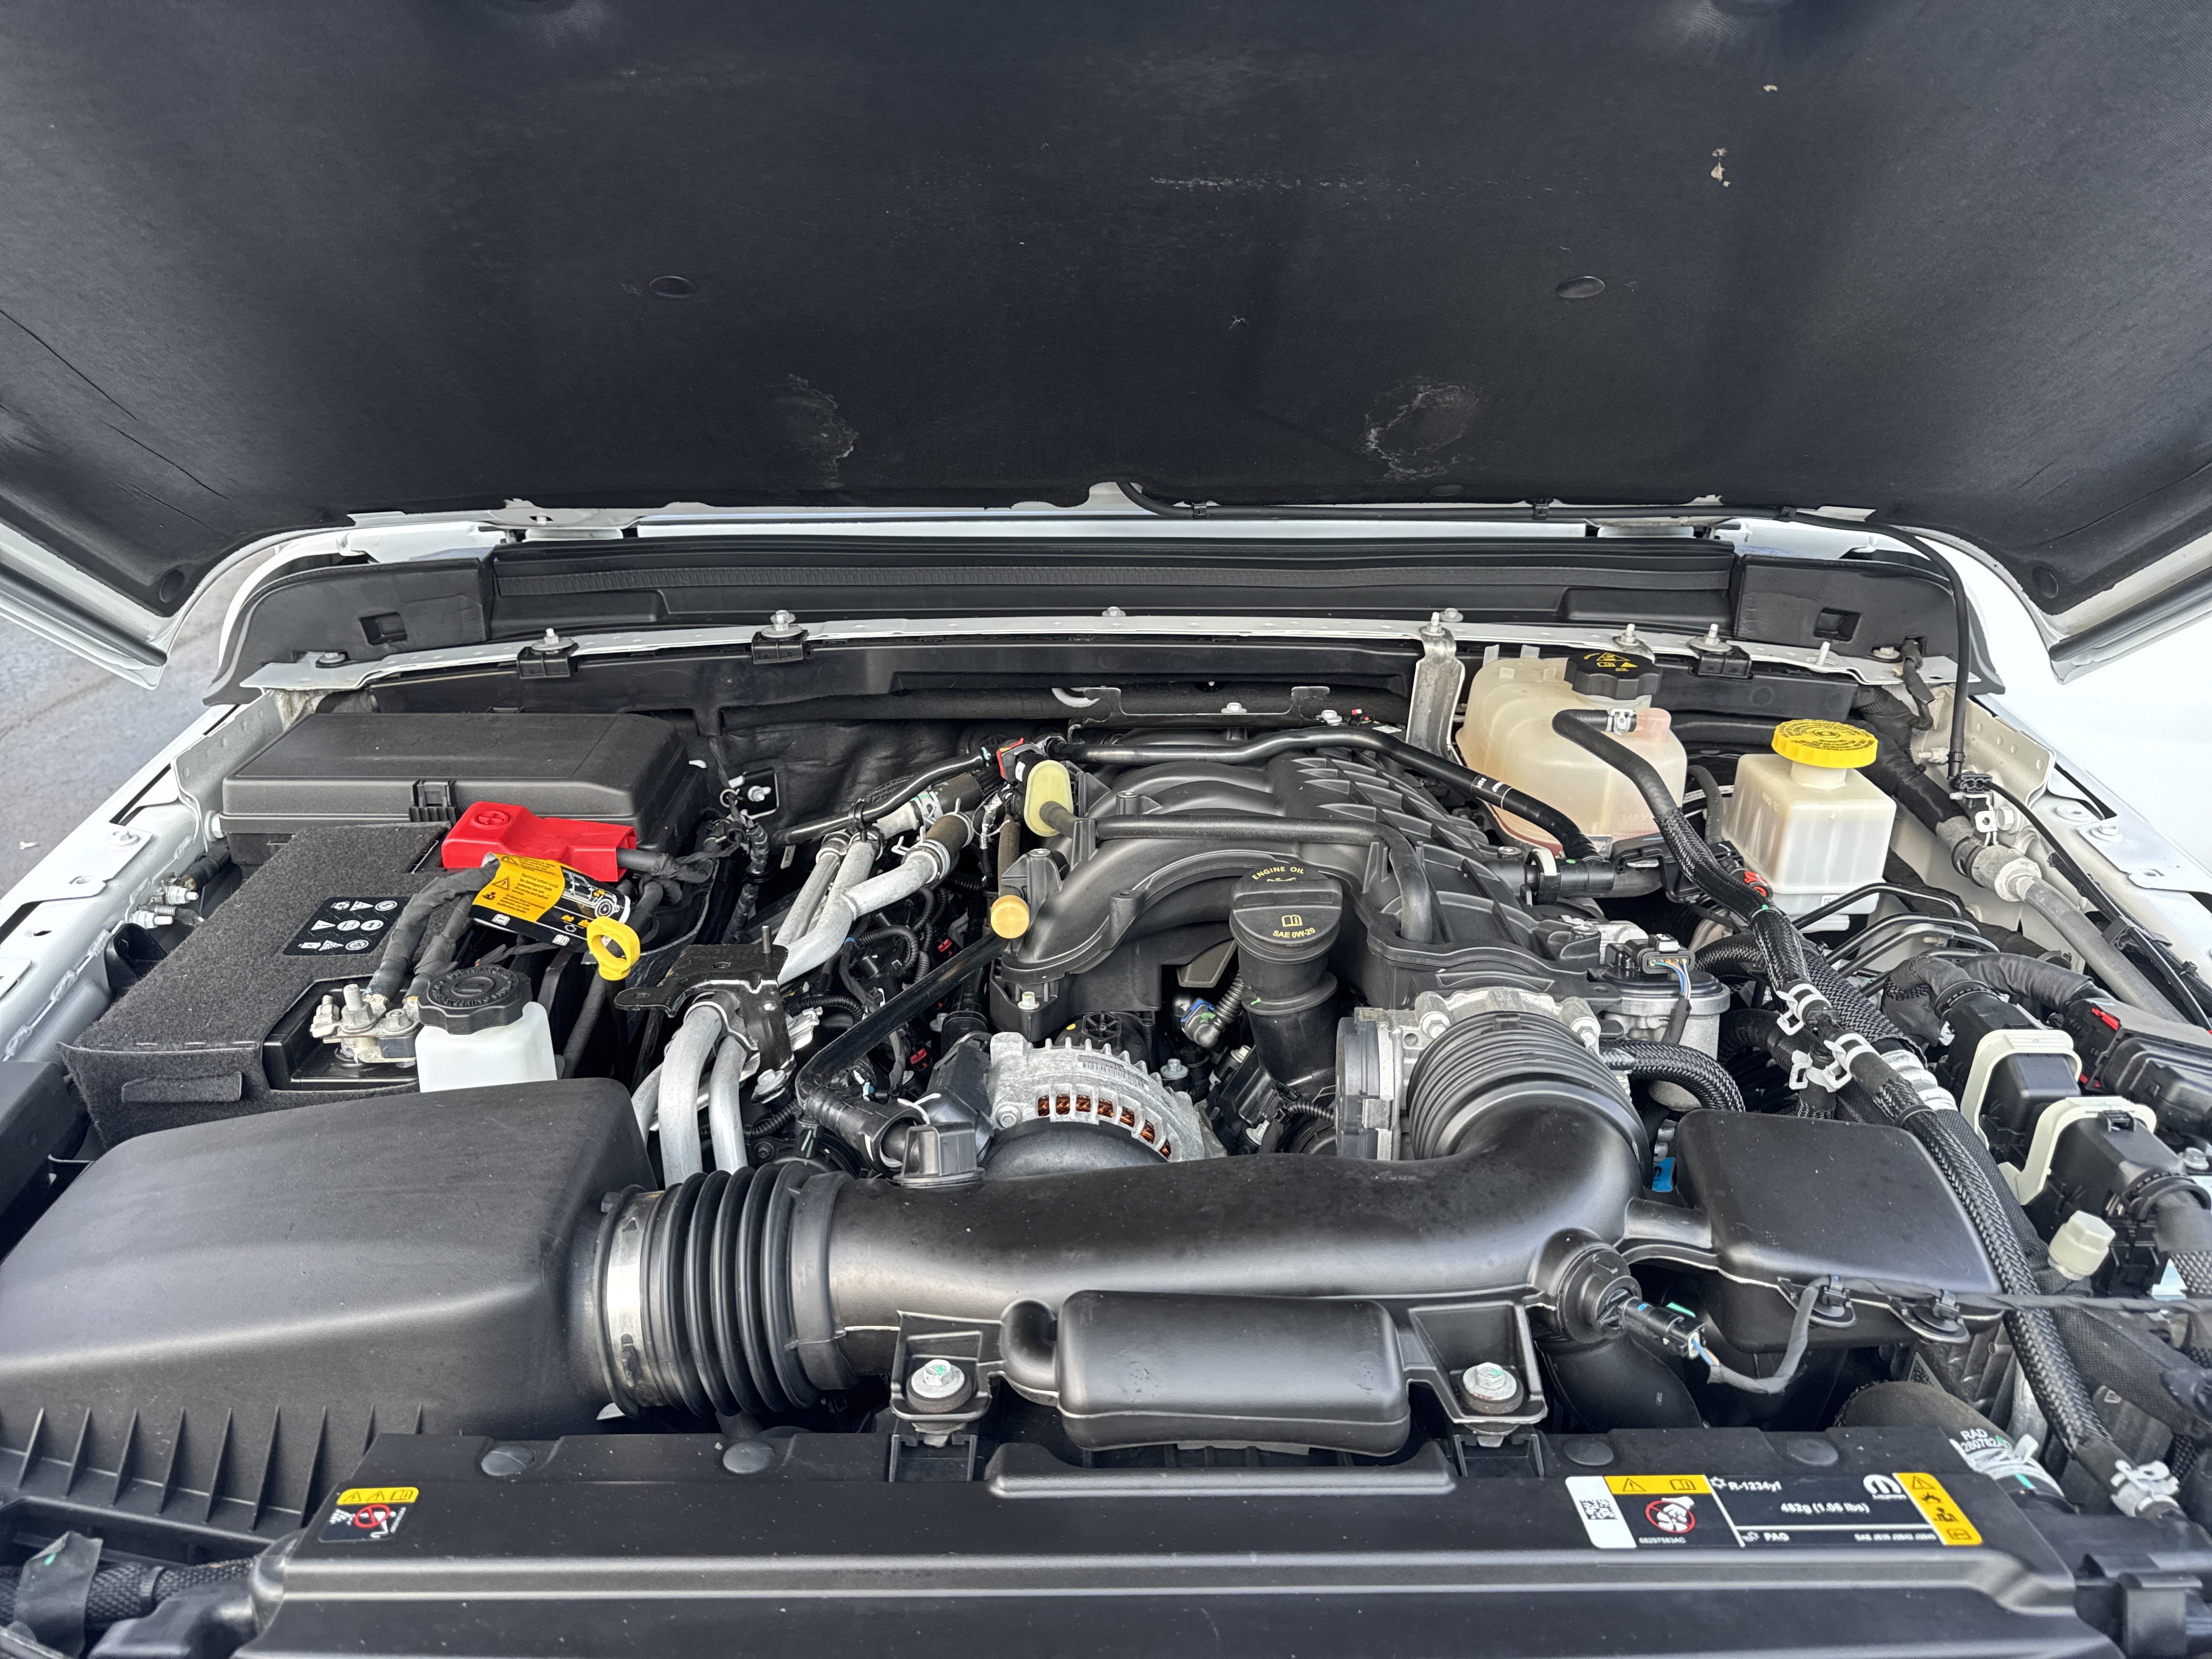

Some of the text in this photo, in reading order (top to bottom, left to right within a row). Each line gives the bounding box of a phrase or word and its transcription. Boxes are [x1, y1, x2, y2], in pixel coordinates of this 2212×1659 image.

[1252, 866, 1304, 880] ENGINE OIL
[1273, 927, 1316, 938] SAE 0W-20
[1960, 1428, 1988, 1440] RAD
[1728, 1481, 1782, 1493] R-1234yf
[1763, 1532, 1790, 1542] PAG
